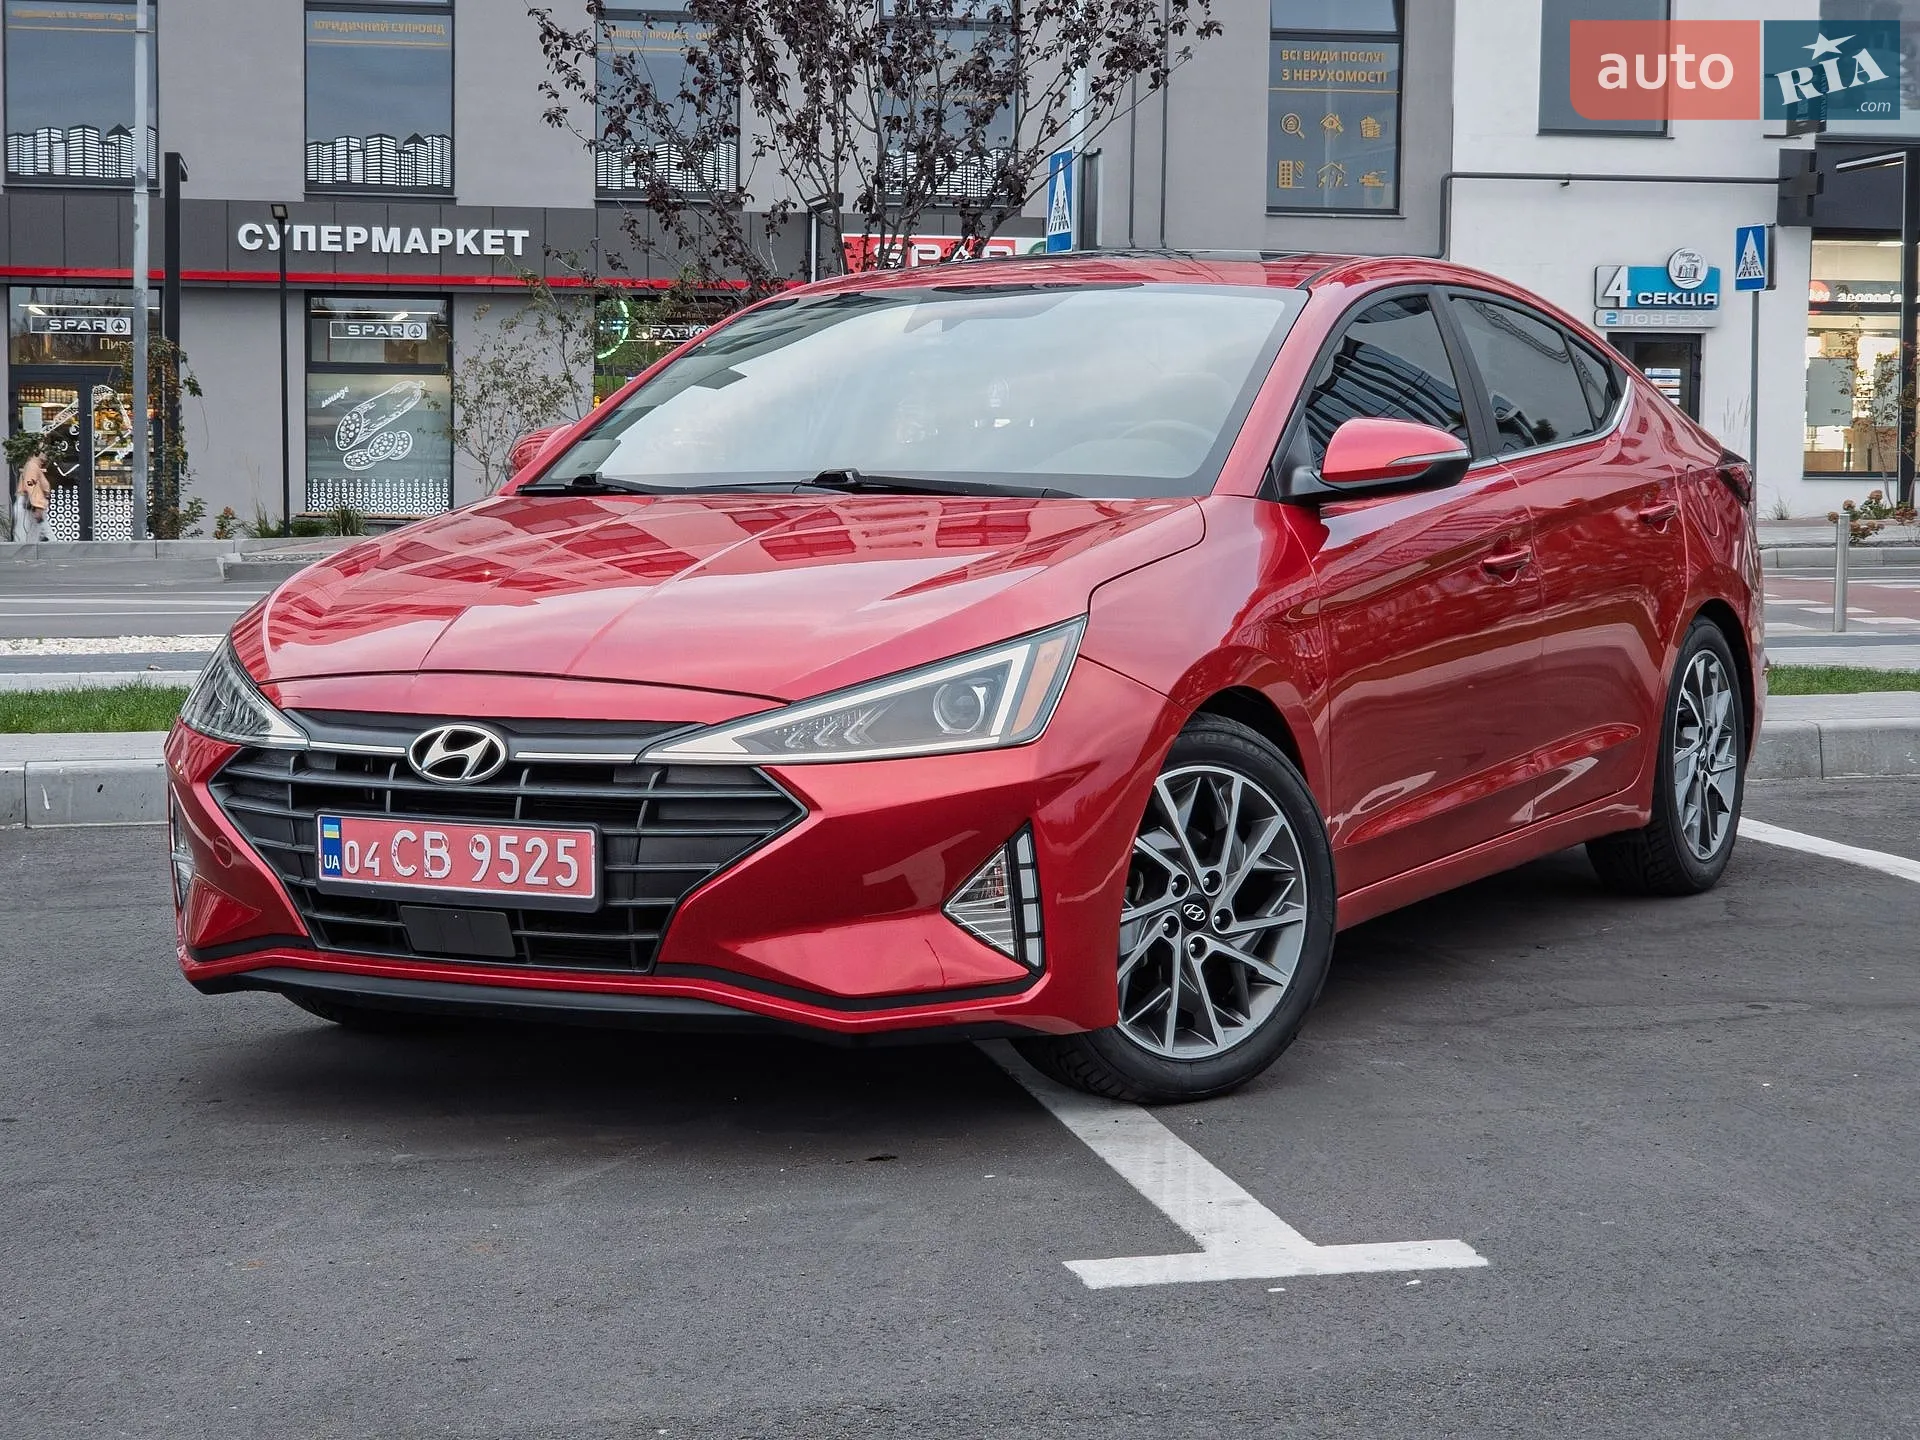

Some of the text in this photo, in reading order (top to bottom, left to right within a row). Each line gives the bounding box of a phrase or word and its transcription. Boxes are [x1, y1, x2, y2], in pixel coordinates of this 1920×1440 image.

[1281, 49, 1300, 61] ВСІ
[1303, 50, 1338, 64] ВИДИ
[1293, 69, 1387, 83] НЕРУХОМОСТІ
[237, 223, 530, 256] СУПЕРМАРКЕТ
[1603, 265, 1718, 308] 4 СЕКЦІЯ
[48, 319, 106, 331] SPAR
[1604, 312, 1618, 325] 2
[347, 324, 404, 336] SPAR
[324, 829, 579, 888] UA 04 CB 9525
